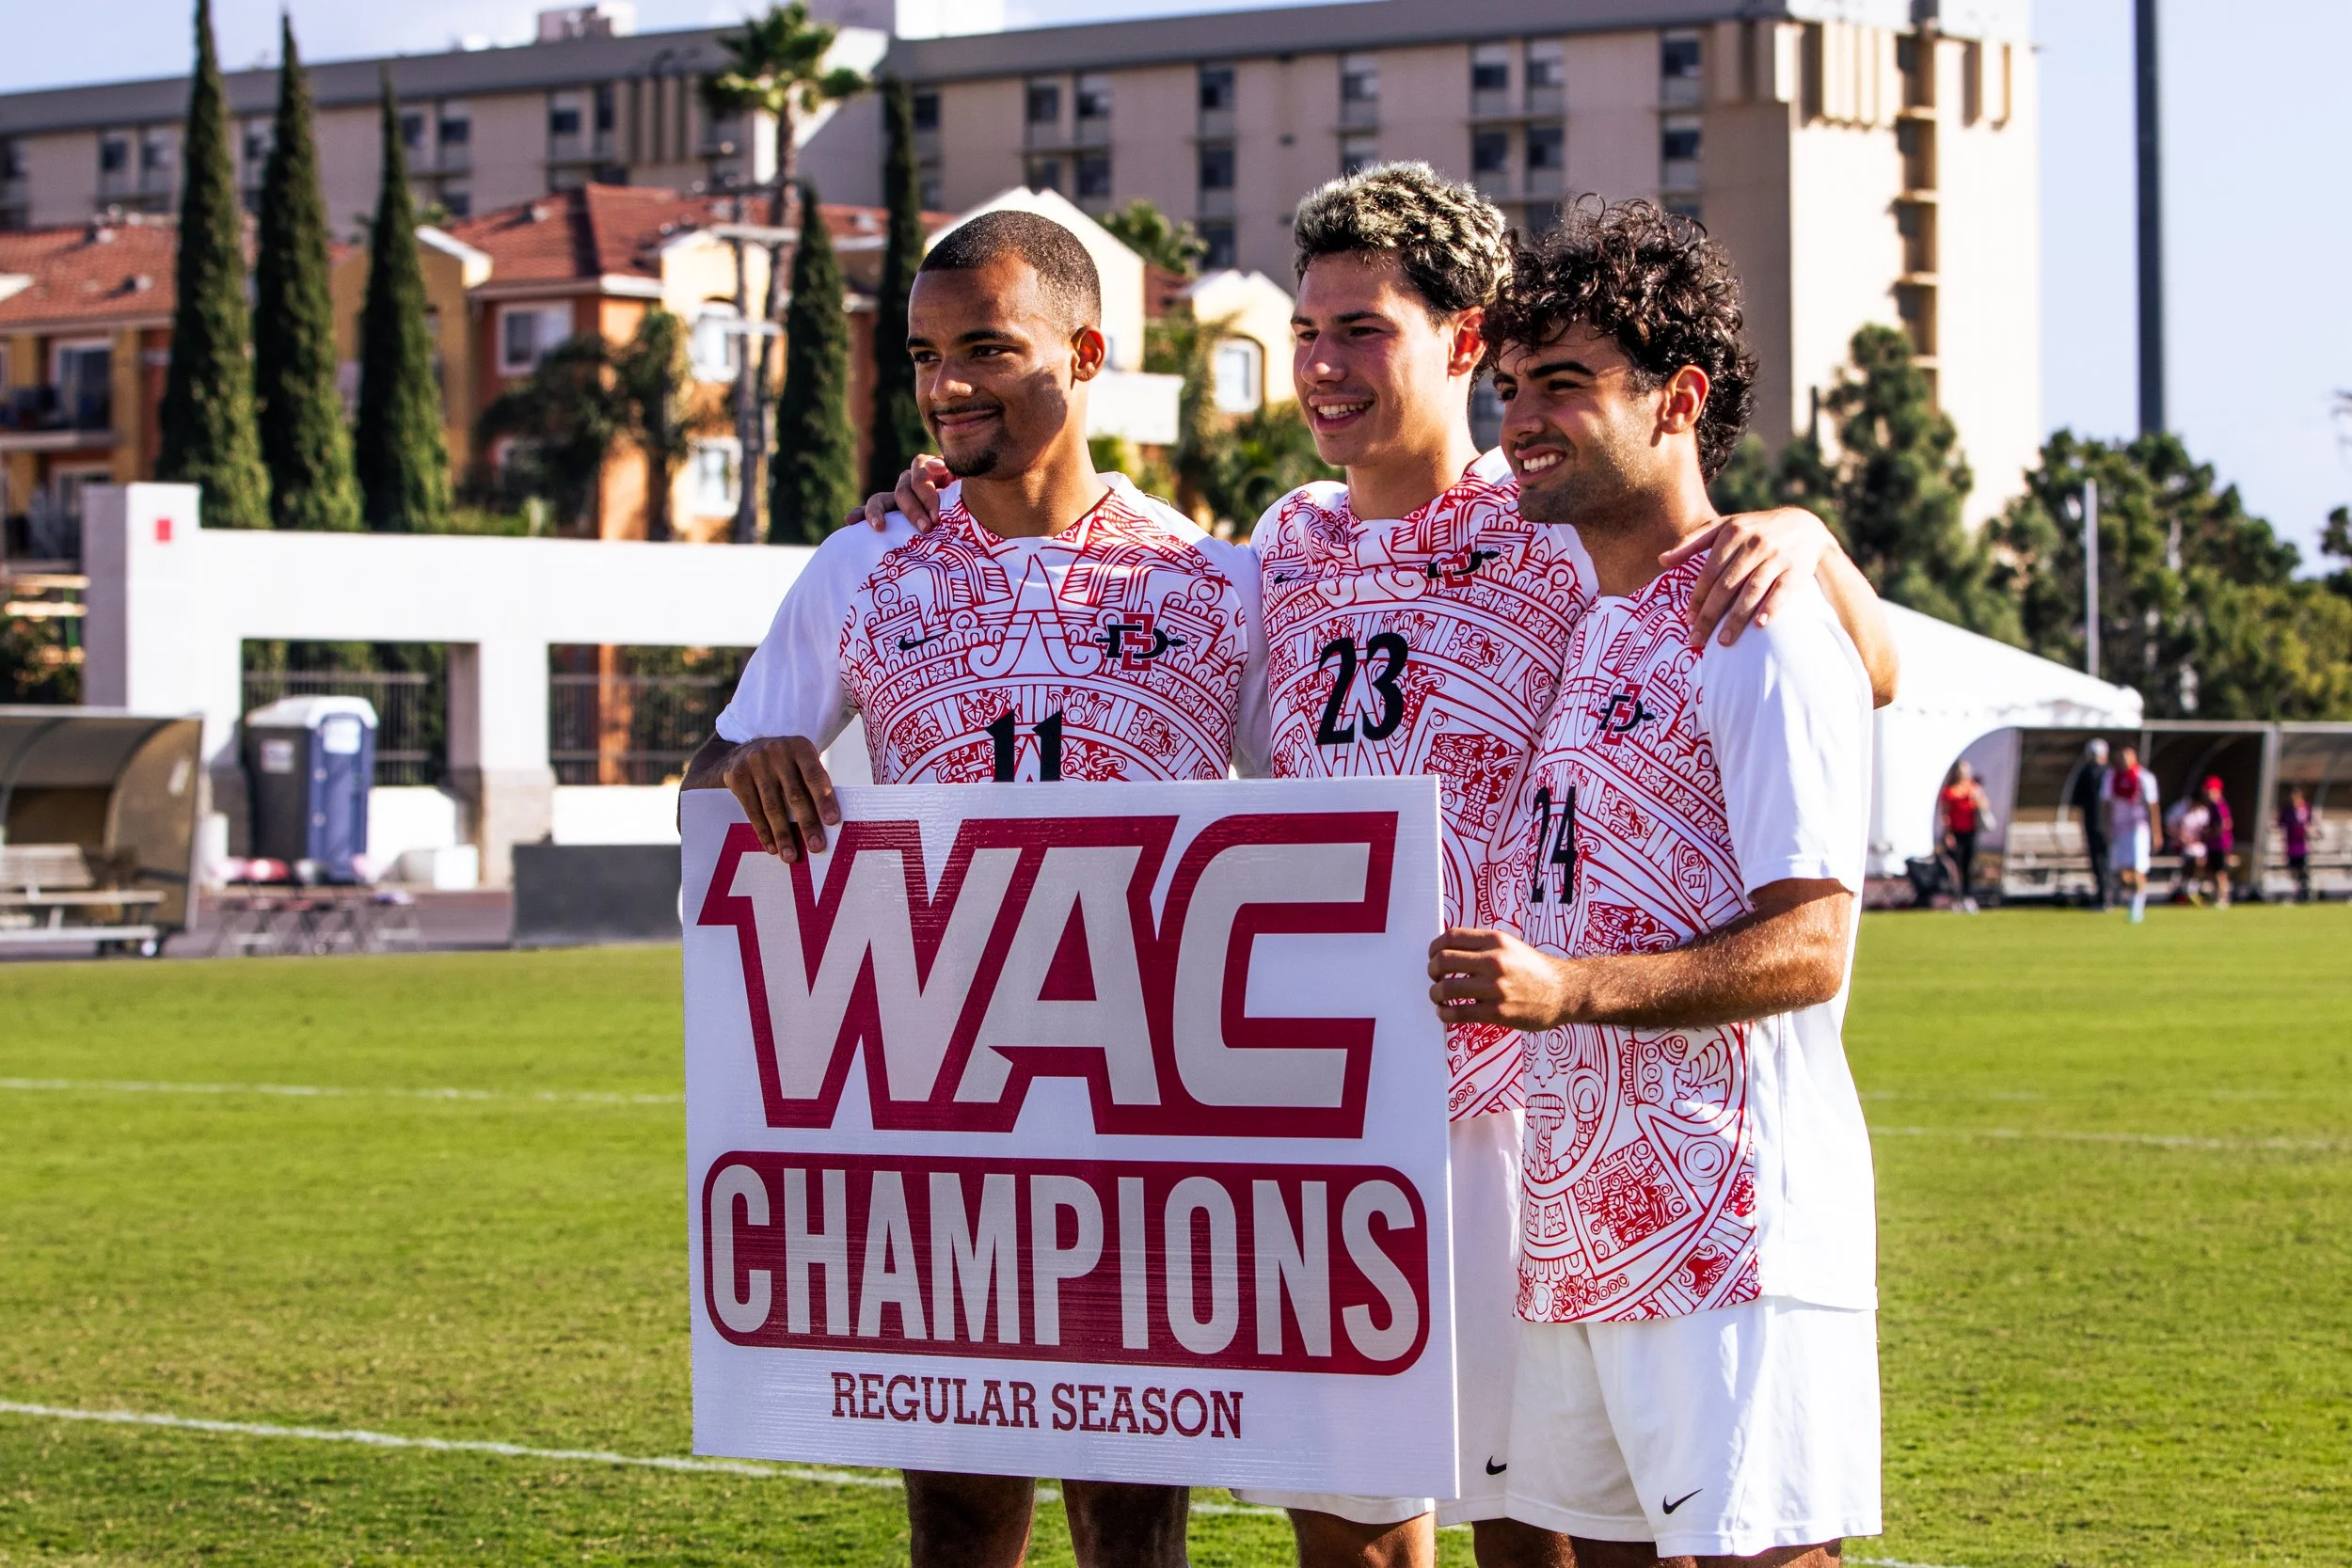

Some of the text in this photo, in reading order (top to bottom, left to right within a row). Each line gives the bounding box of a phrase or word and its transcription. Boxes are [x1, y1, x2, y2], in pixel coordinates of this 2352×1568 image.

[985, 708, 1062, 783] 11
[1316, 631, 1409, 745] 23
[1531, 785, 1578, 904] 24
[698, 811, 1398, 1138] WAC
[710, 1163, 1421, 1362] CHAMPIONS
[831, 1371, 1243, 1439] REGULAR SEASON
